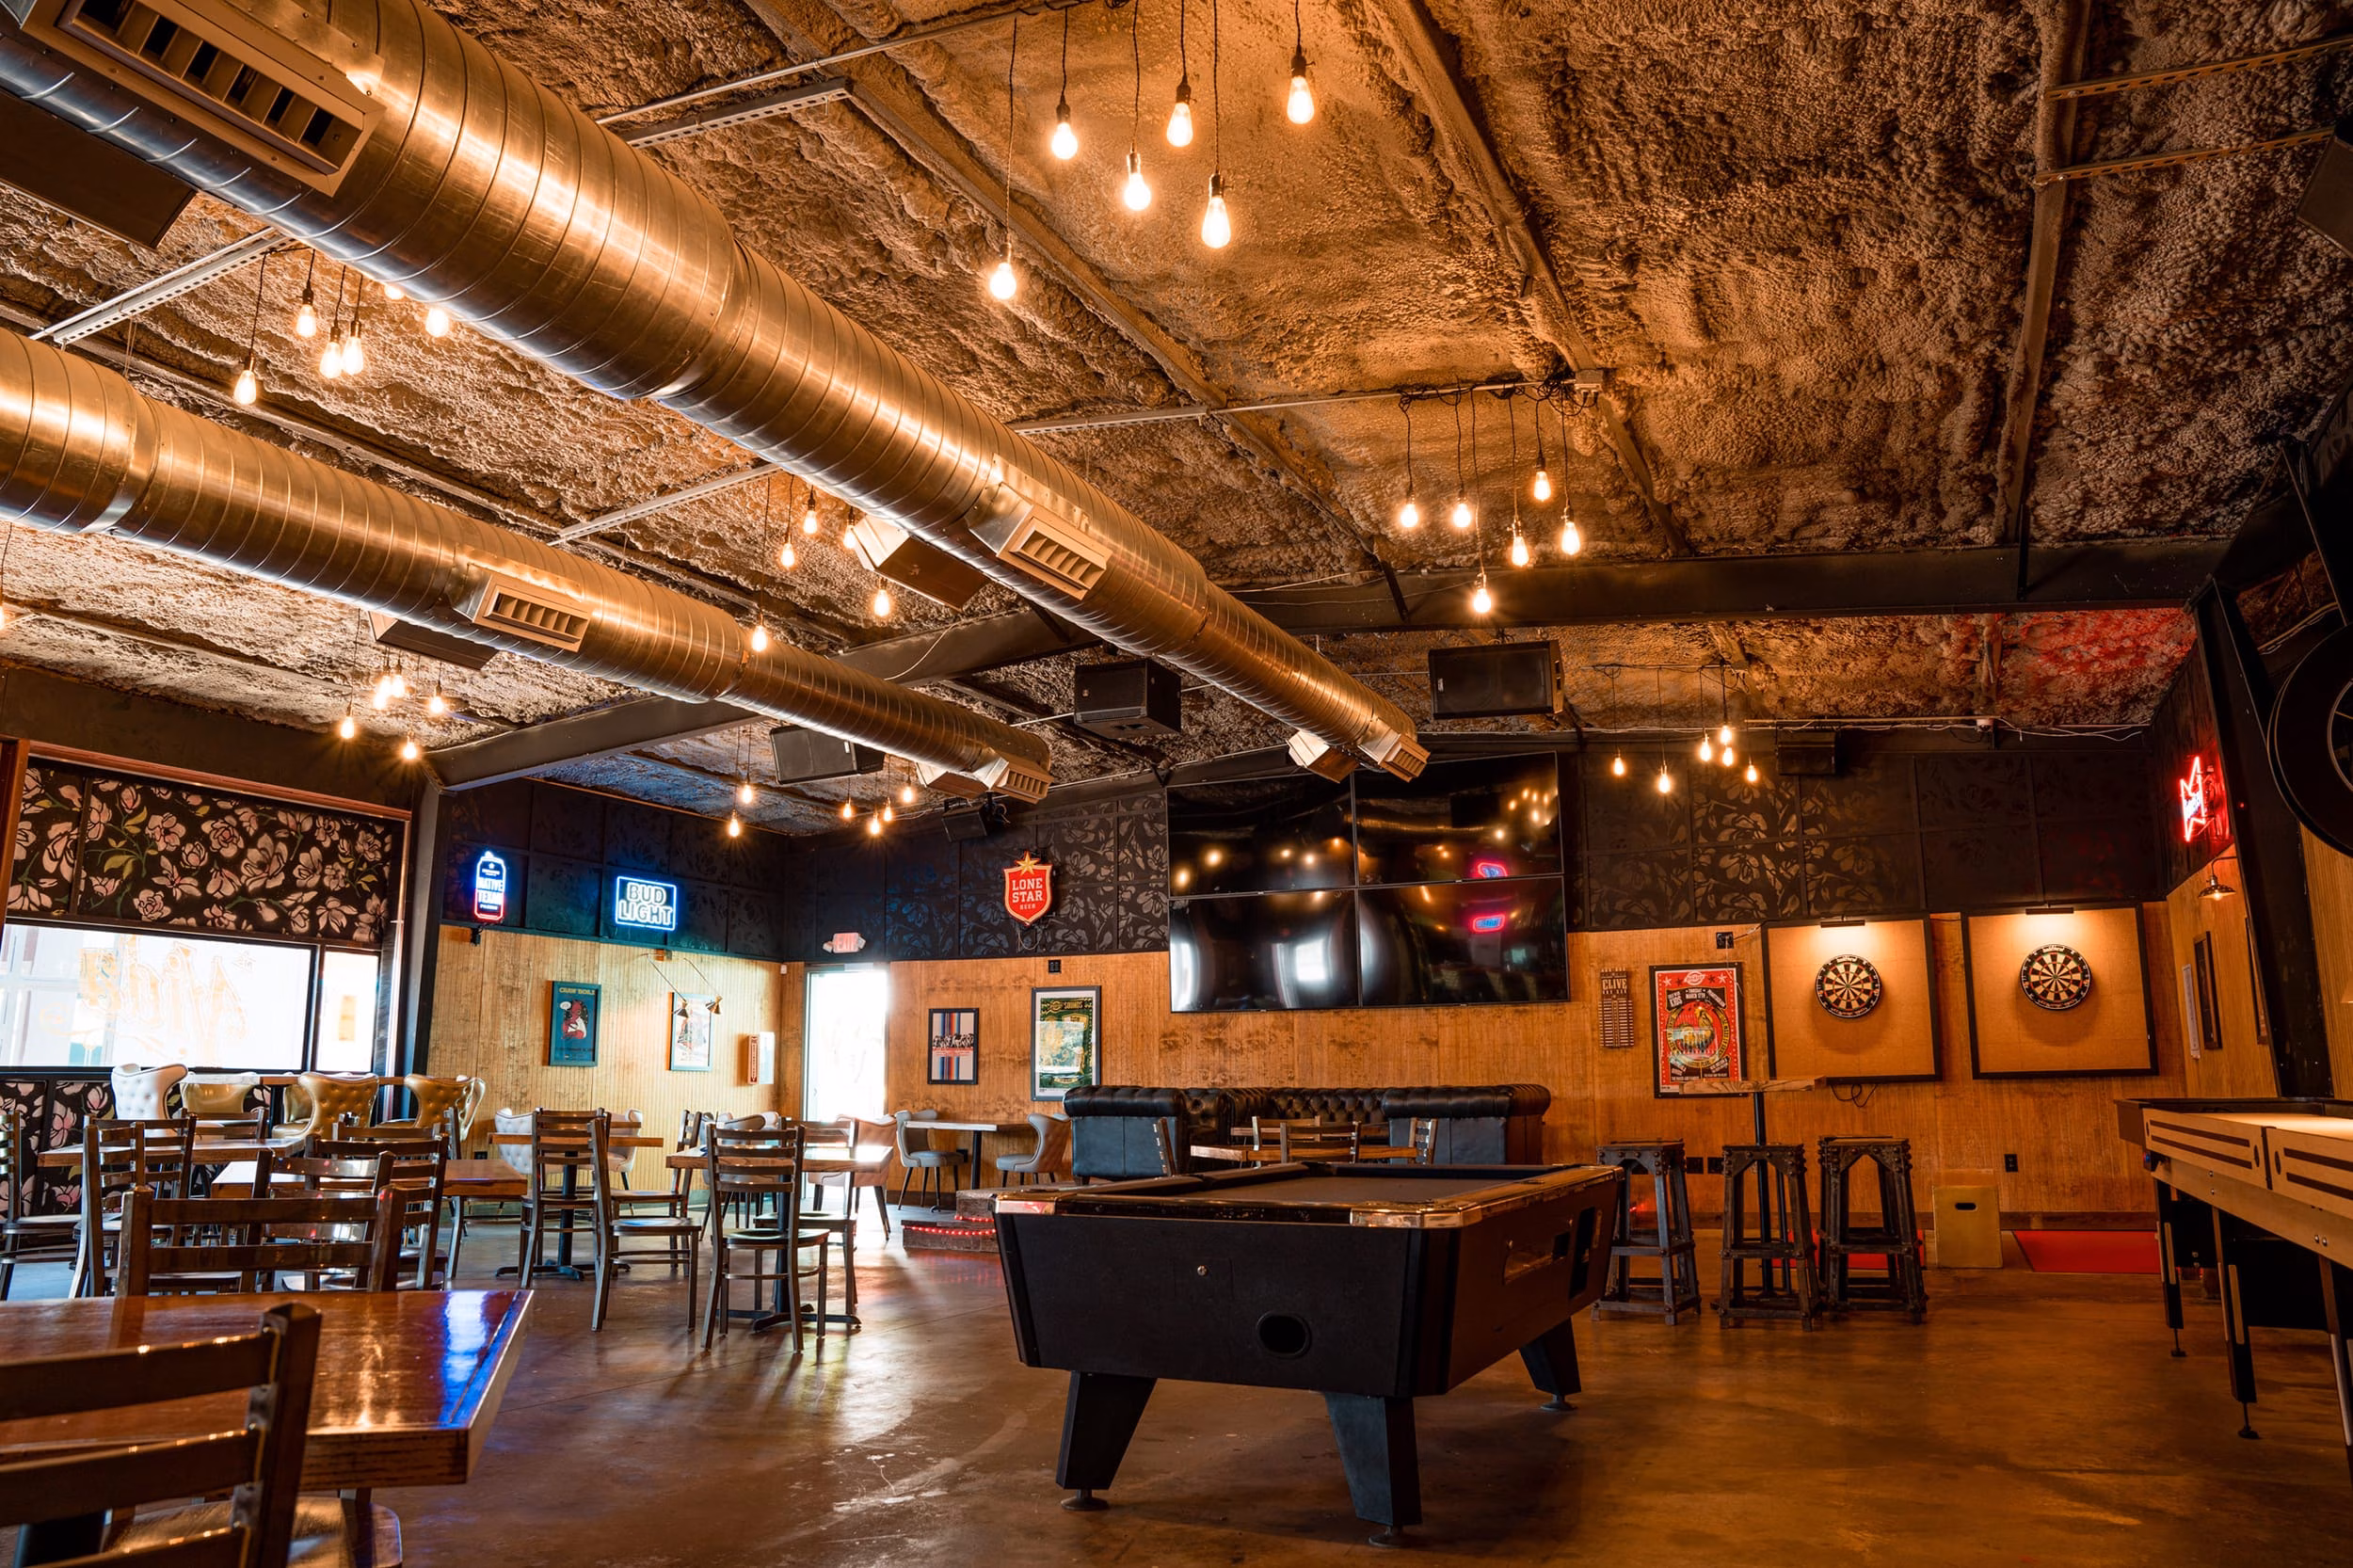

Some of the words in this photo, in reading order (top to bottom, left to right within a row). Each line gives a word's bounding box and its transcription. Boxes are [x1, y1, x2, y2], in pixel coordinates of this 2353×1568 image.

[478, 877, 503, 892] NATIVE
[1012, 877, 1043, 891] LONE
[627, 882, 667, 905] BUD
[1012, 890, 1043, 904] STAR
[618, 900, 673, 926] LIGHT
[1602, 979, 1627, 990] CLIVE
[1064, 1001, 1083, 1010] SOUNDS
